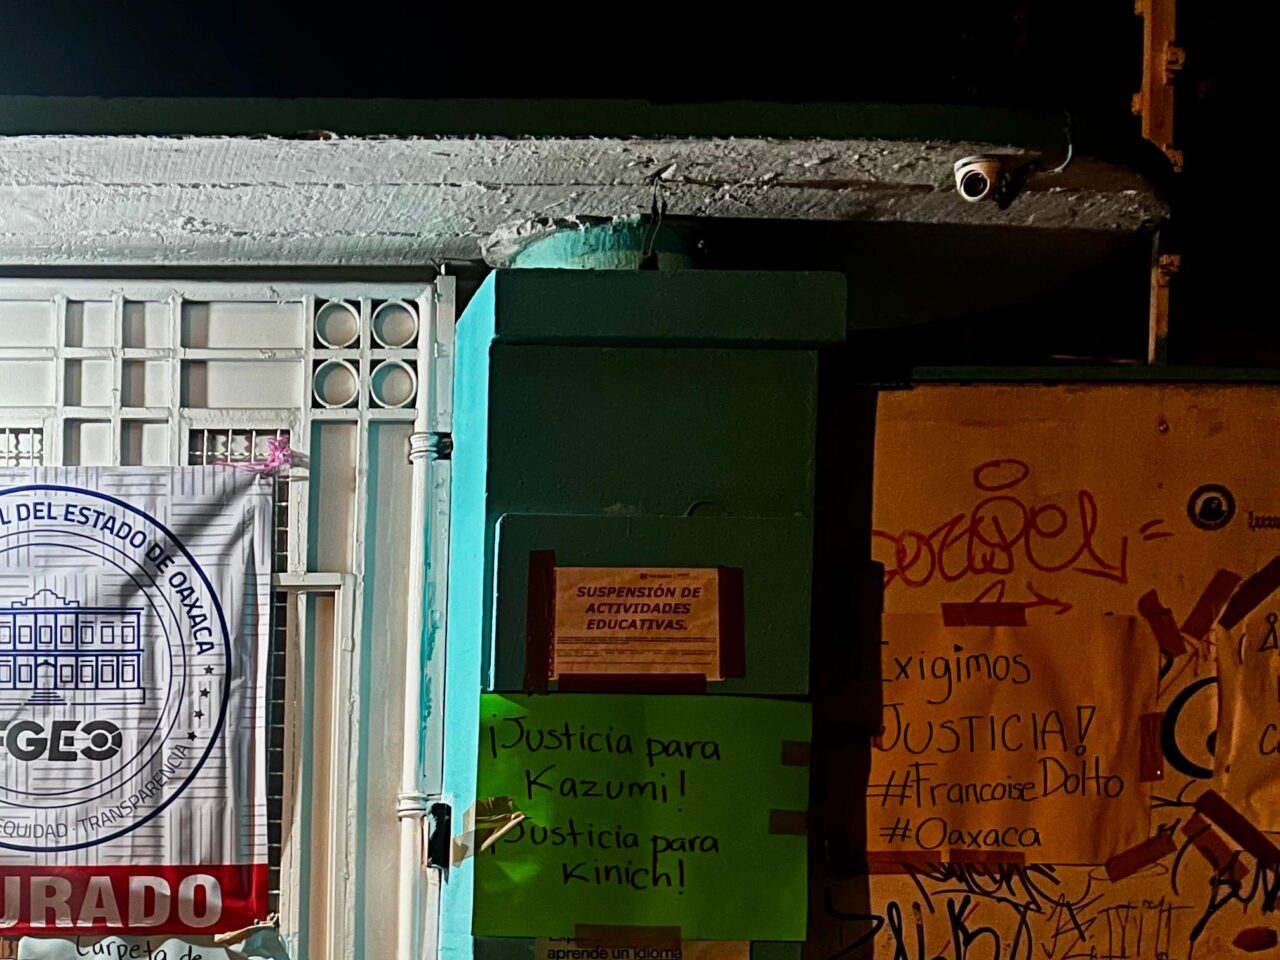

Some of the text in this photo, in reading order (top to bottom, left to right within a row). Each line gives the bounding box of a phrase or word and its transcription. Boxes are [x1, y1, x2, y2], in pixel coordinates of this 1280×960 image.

[16, 502, 58, 522] DEL
[63, 503, 148, 549] ESTADO
[145, 542, 175, 575] DE
[168, 571, 215, 656] OAXACA
[576, 583, 702, 599] SUSPENSIÓN DE
[585, 602, 692, 615] ACTIVIDADES
[586, 618, 688, 631] EDUCATIVAS.
[489, 713, 721, 767] ¡Justicia para
[874, 703, 1097, 756] JUSTICIA!
[78, 743, 191, 834] TRANSPARENCIA
[650, 831, 720, 863] para
[879, 816, 1042, 849] #Oaxaca
[547, 947, 683, 960] aprende un idioma
